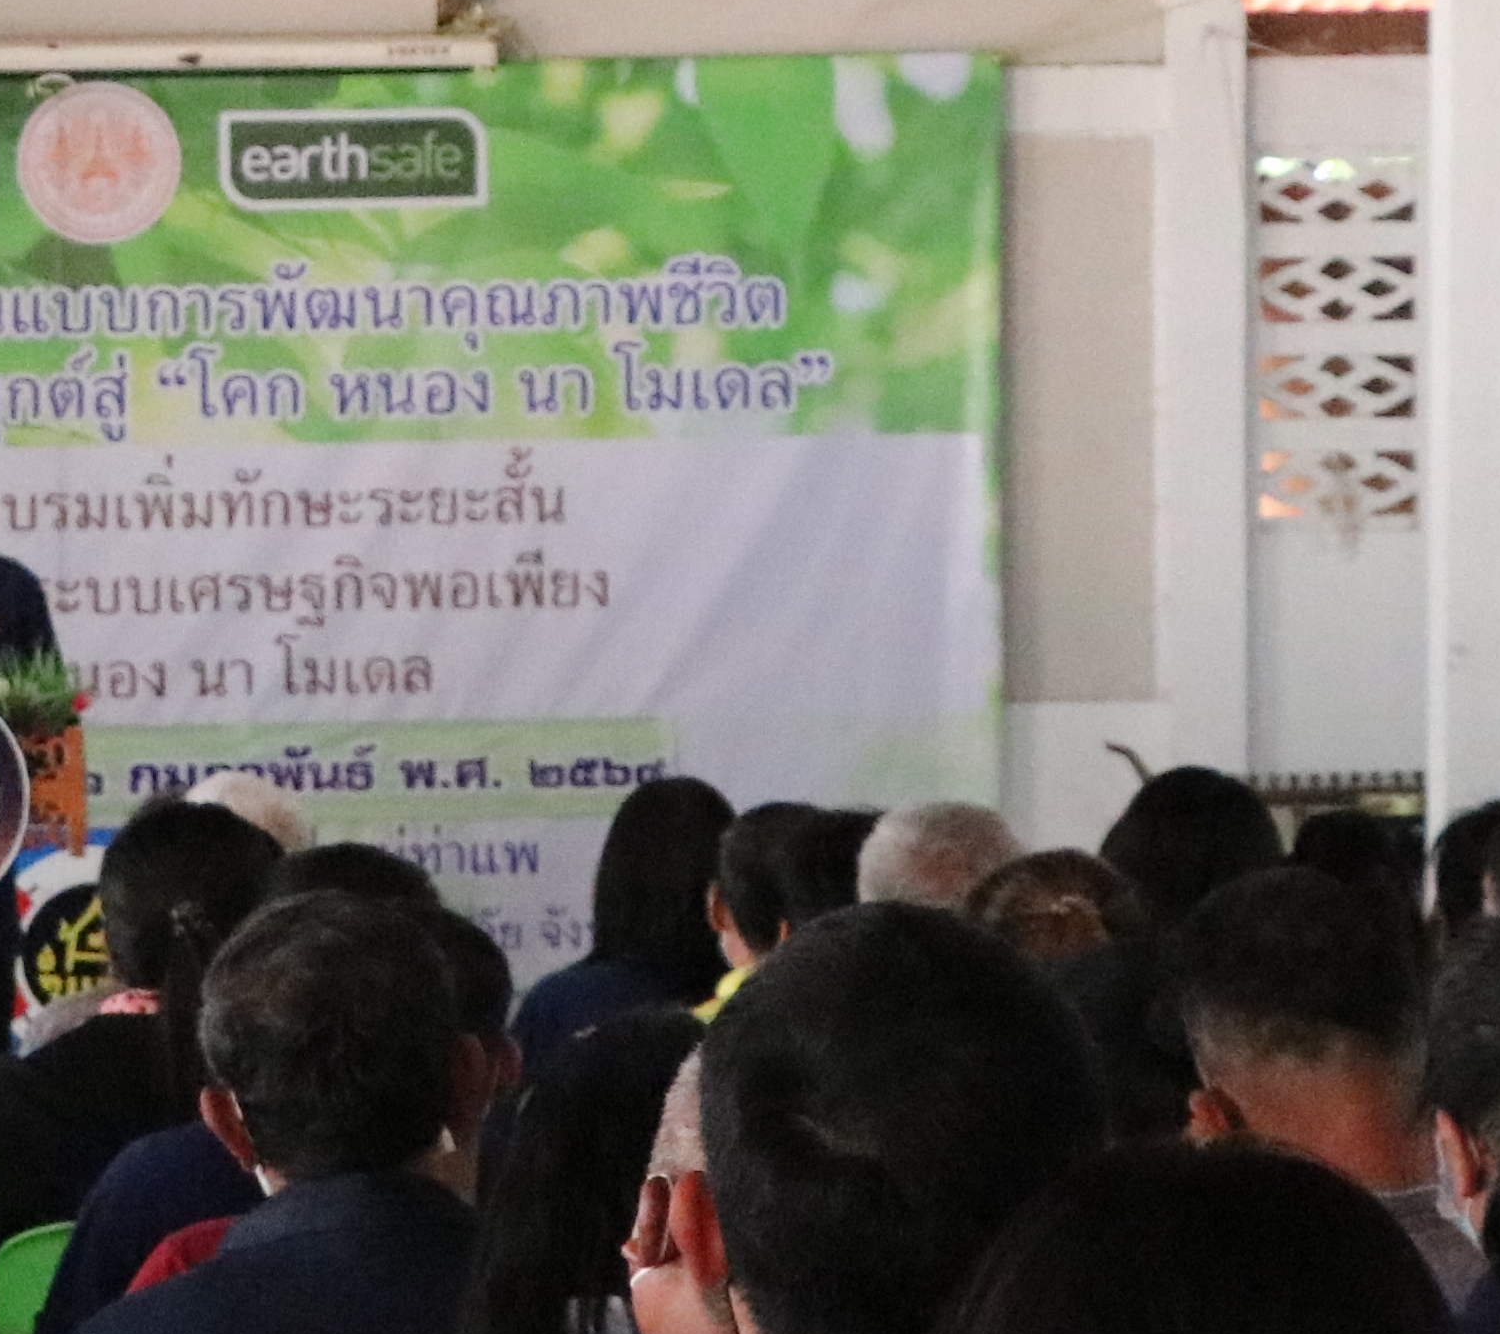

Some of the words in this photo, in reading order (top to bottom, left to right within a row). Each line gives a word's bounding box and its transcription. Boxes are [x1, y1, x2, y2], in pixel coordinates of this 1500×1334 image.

[240, 130, 462, 182] earthsafe
[330, 367, 490, 415] หนอง
[520, 367, 592, 415] นา
[194, 655, 256, 696] นา
[276, 633, 434, 696] โมเดล
[401, 757, 502, 789] พ.ศ.
